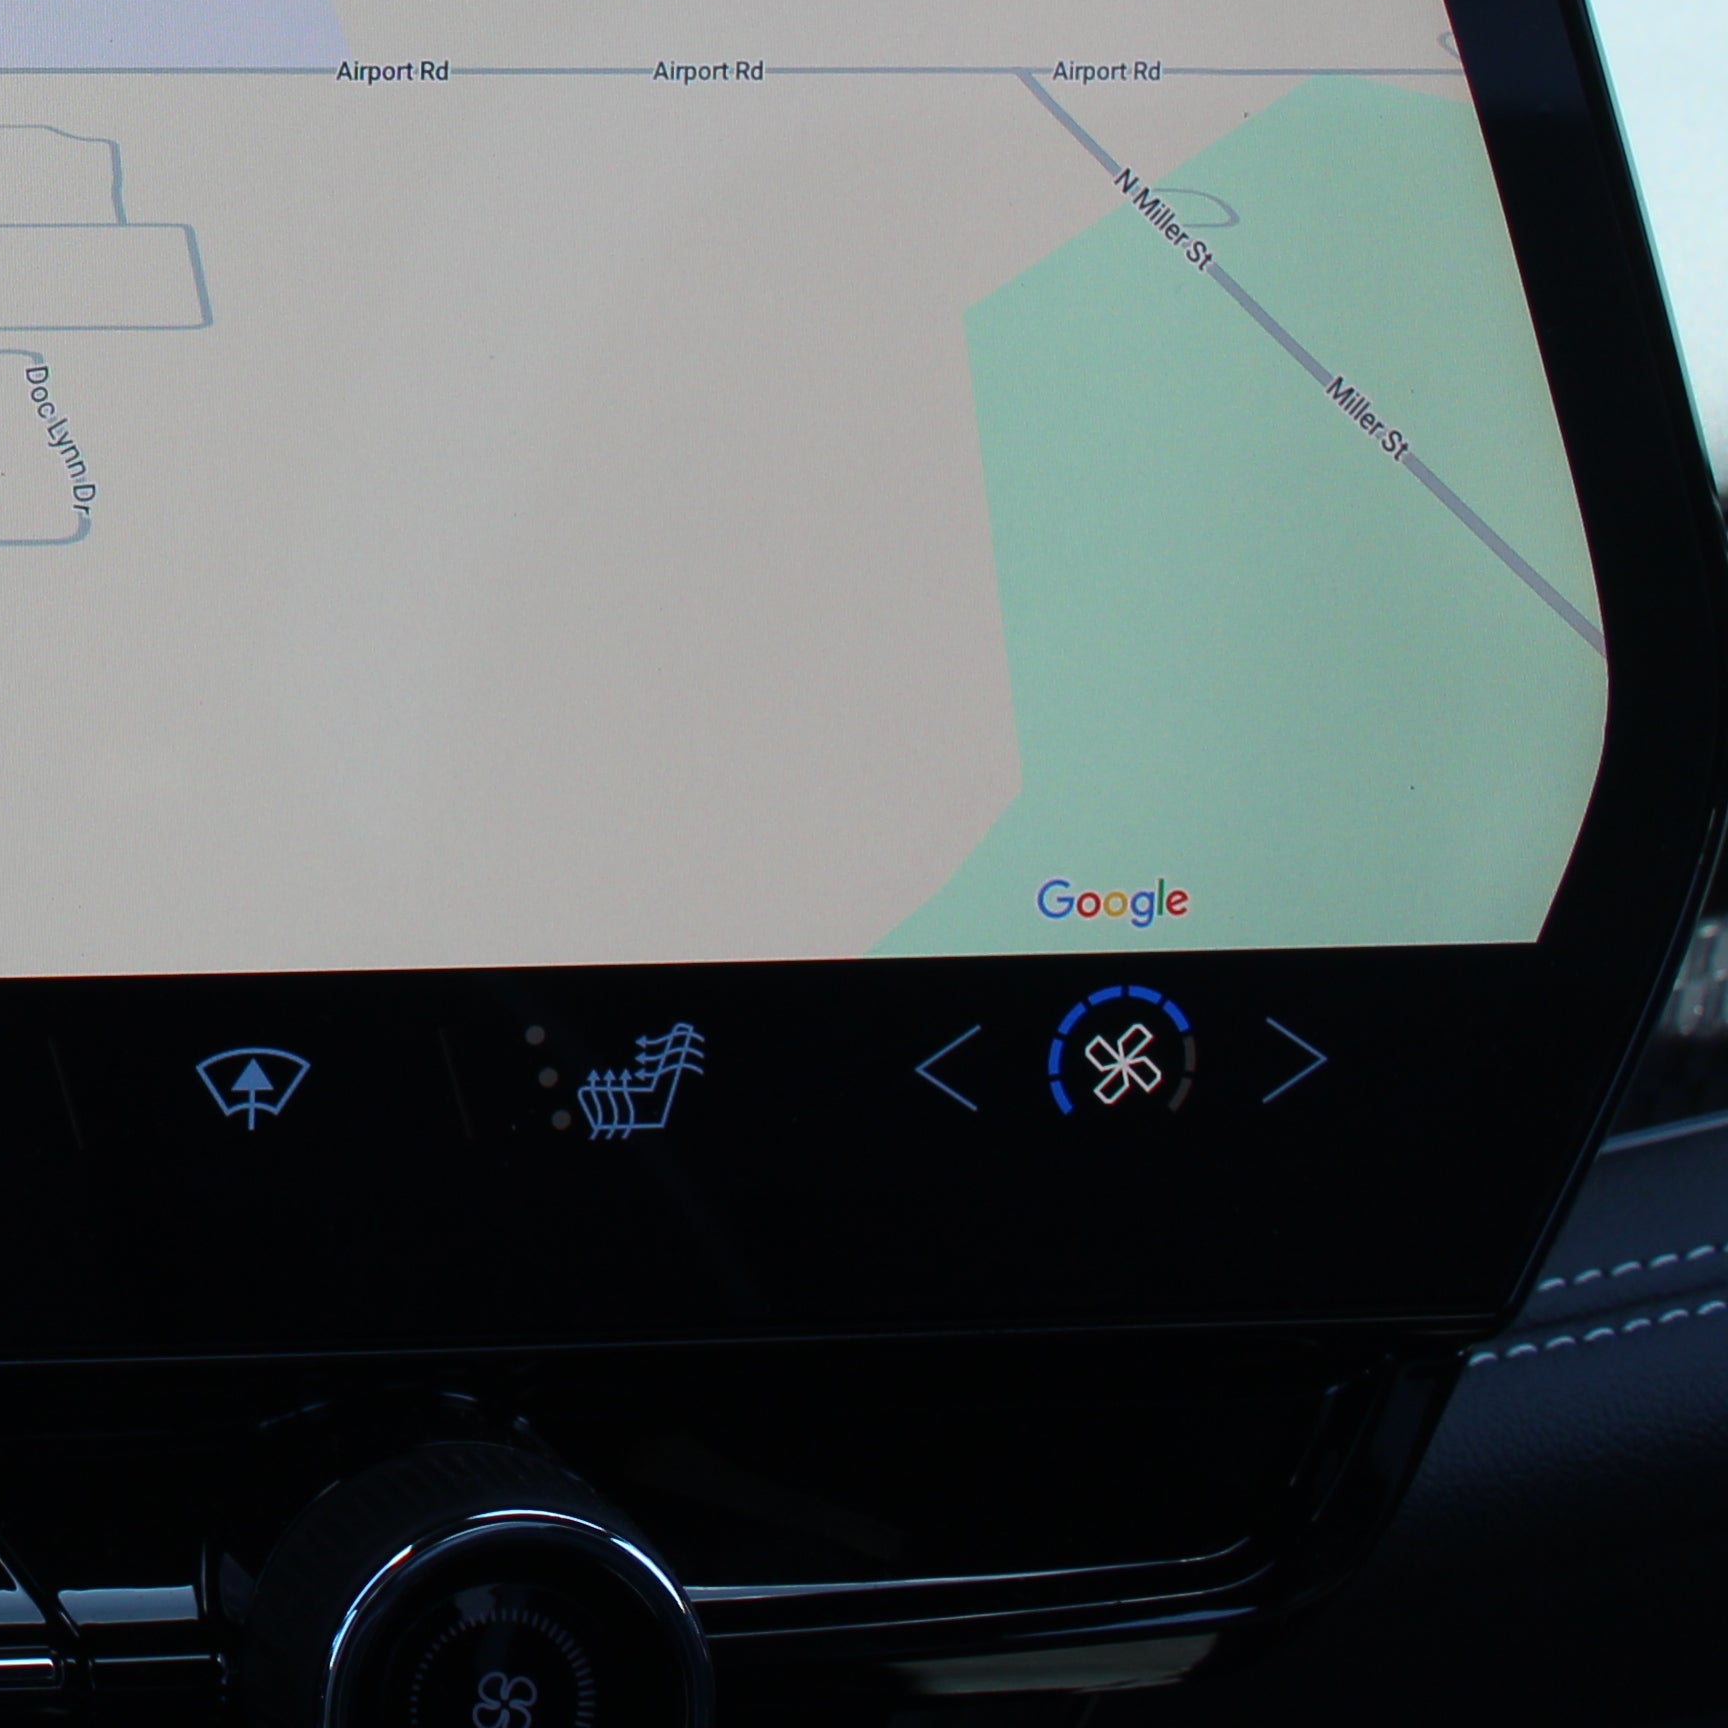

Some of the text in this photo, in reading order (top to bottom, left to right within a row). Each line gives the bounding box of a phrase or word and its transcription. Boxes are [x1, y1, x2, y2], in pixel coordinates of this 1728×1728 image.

[337, 60, 449, 86] Airport Rd
[653, 60, 764, 86] Airport Rd
[1053, 62, 1161, 84] Airport Rd
[1114, 168, 1214, 271] N Miller St
[25, 364, 97, 516] Doc Lynn Dr
[1326, 377, 1409, 462] Miller St
[1037, 878, 1188, 927] Google
